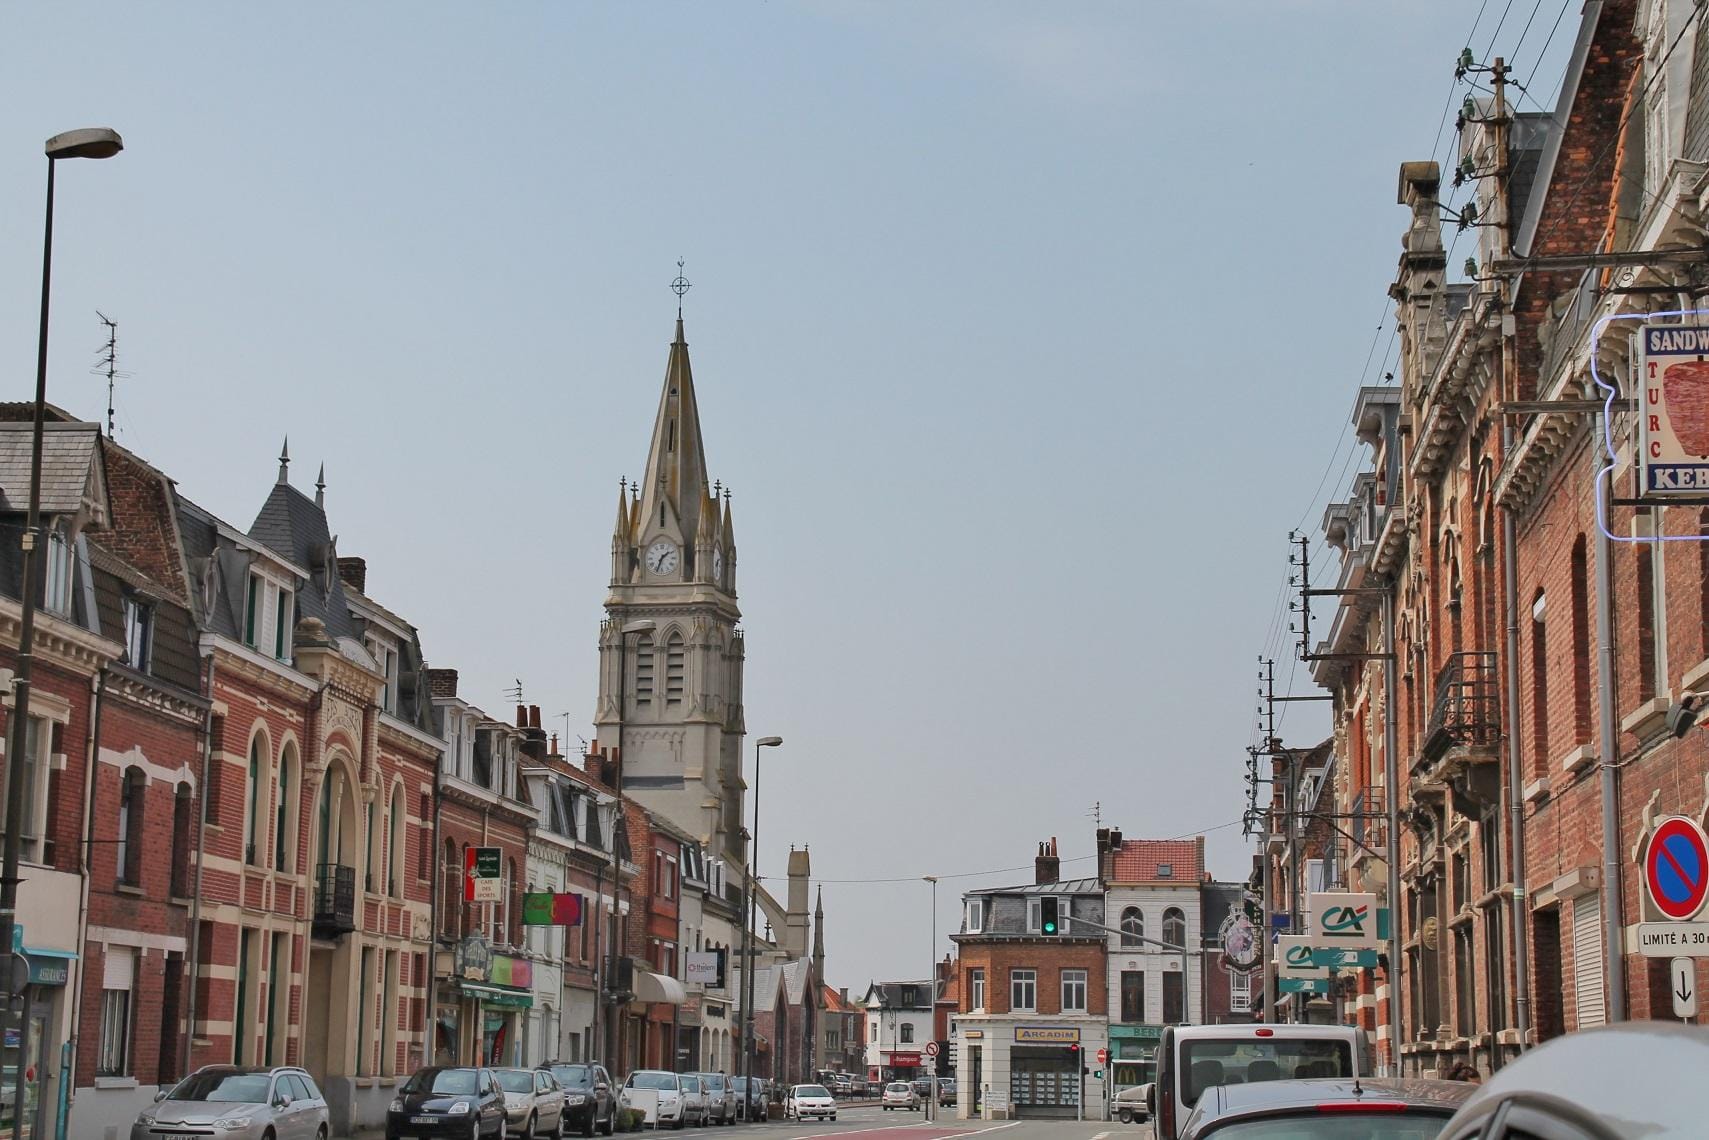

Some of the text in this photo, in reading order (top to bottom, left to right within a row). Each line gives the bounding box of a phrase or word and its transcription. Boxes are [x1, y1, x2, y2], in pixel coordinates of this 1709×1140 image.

[1650, 330, 1709, 351] SANDW
[1647, 361, 1661, 458] TURC
[1654, 468, 1709, 489] KEB
[1643, 932, 1677, 945] LIMITÉ
[1692, 933, 1705, 944] 30
